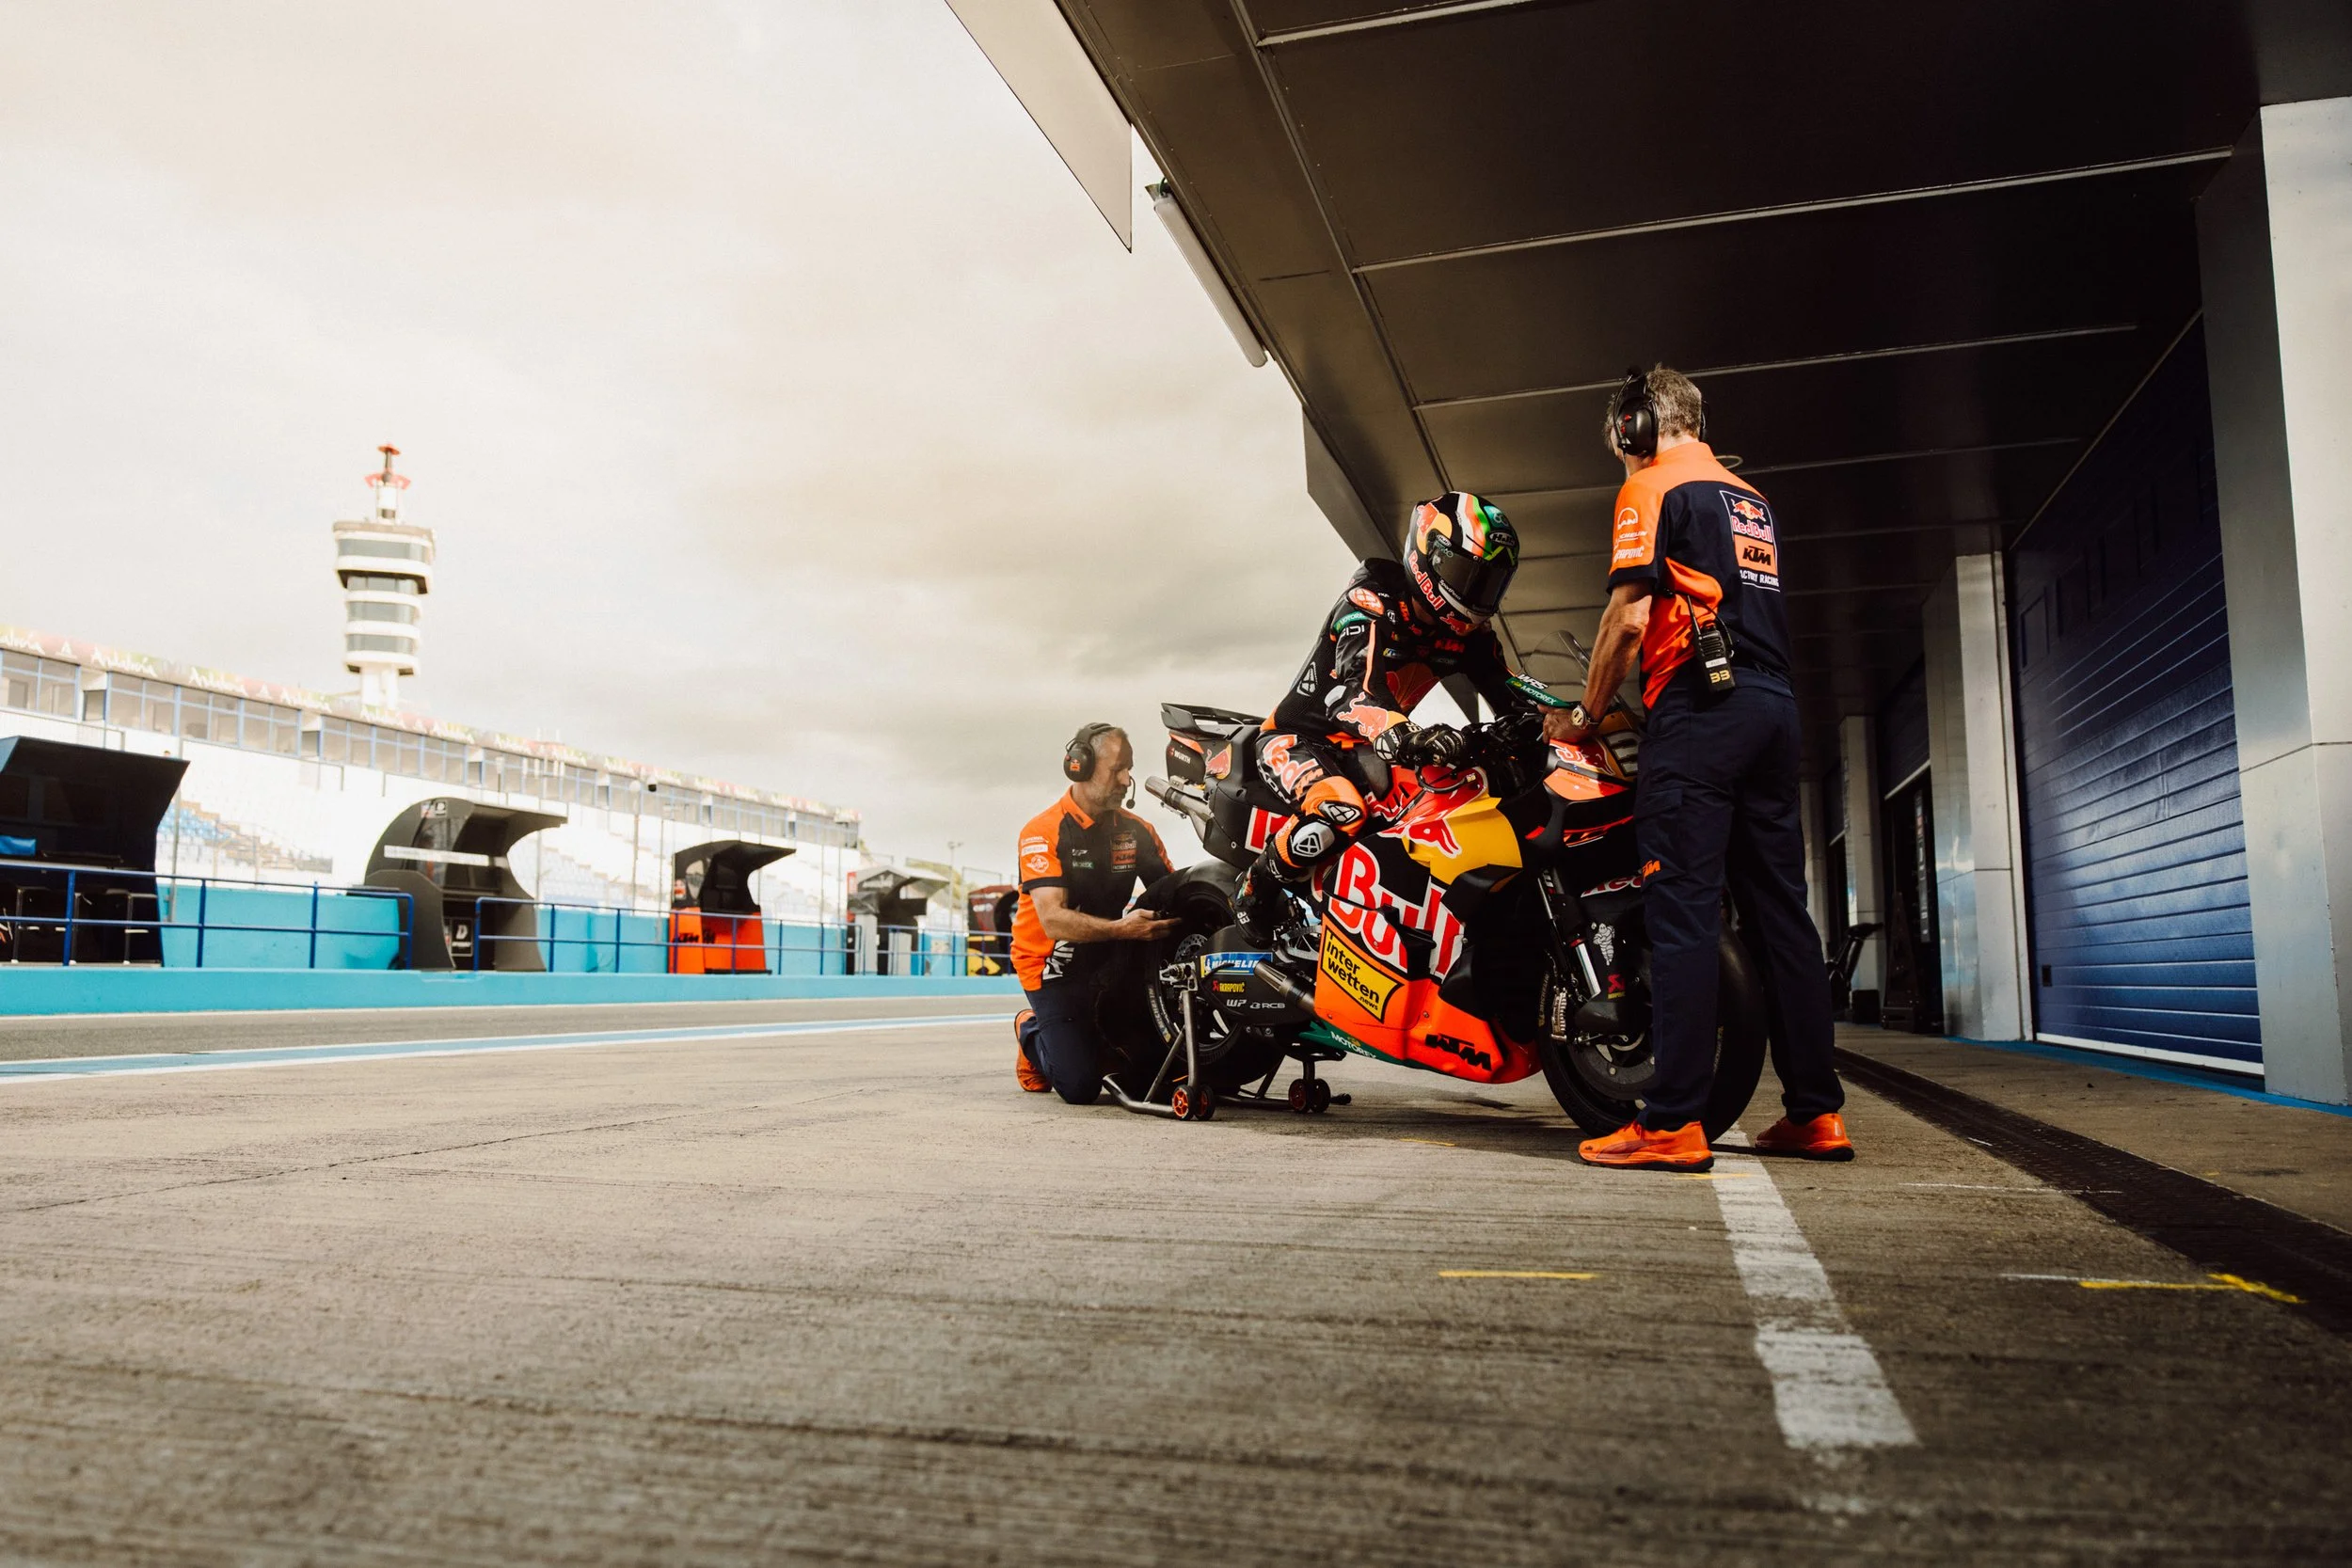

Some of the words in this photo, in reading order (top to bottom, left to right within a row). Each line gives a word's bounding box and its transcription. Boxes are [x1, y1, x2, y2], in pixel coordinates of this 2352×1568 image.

[1731, 515, 1752, 535] Red
[1752, 523, 1772, 544] Bull
[1742, 545, 1772, 566] KTM
[1408, 549, 1427, 585] Red
[1420, 579, 1447, 611] Bull
[1520, 685, 1557, 705] MOTOREX
[1709, 669, 1731, 684] 33
[1262, 734, 1319, 796] Red
[1327, 841, 1465, 985] Bull
[1327, 931, 1361, 975] inter
[1327, 957, 1381, 1005] wetten
[1226, 998, 1248, 1007] WP
[1424, 1033, 1493, 1072] KTM
